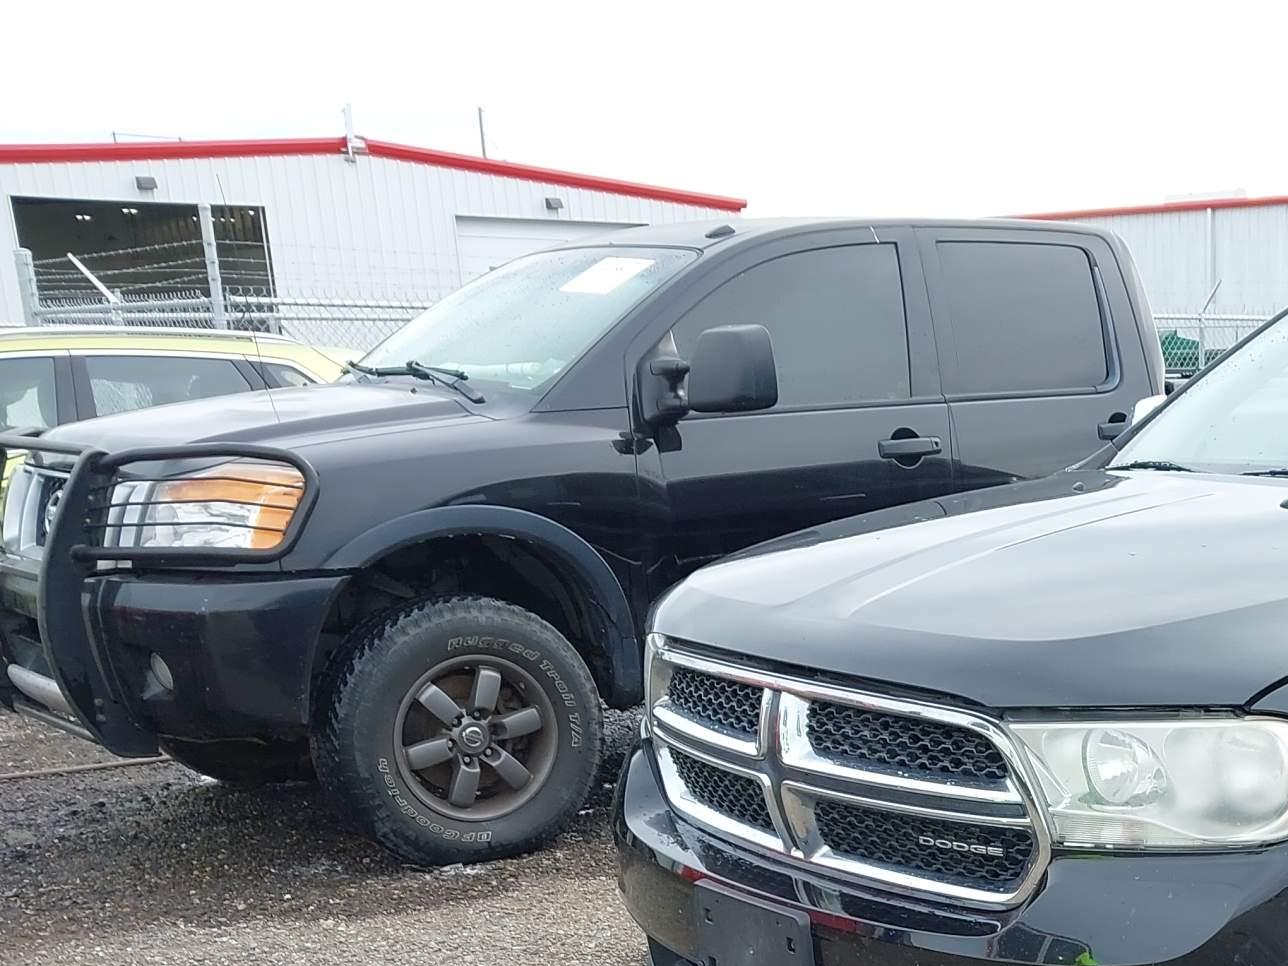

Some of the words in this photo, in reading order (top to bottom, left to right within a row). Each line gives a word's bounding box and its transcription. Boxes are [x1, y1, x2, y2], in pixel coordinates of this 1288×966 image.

[447, 635, 540, 662] Rugged
[538, 659, 577, 708] Trail
[568, 711, 584, 748] T/A
[378, 757, 493, 843] BFGoodrich
[918, 835, 1004, 857] DODGE
